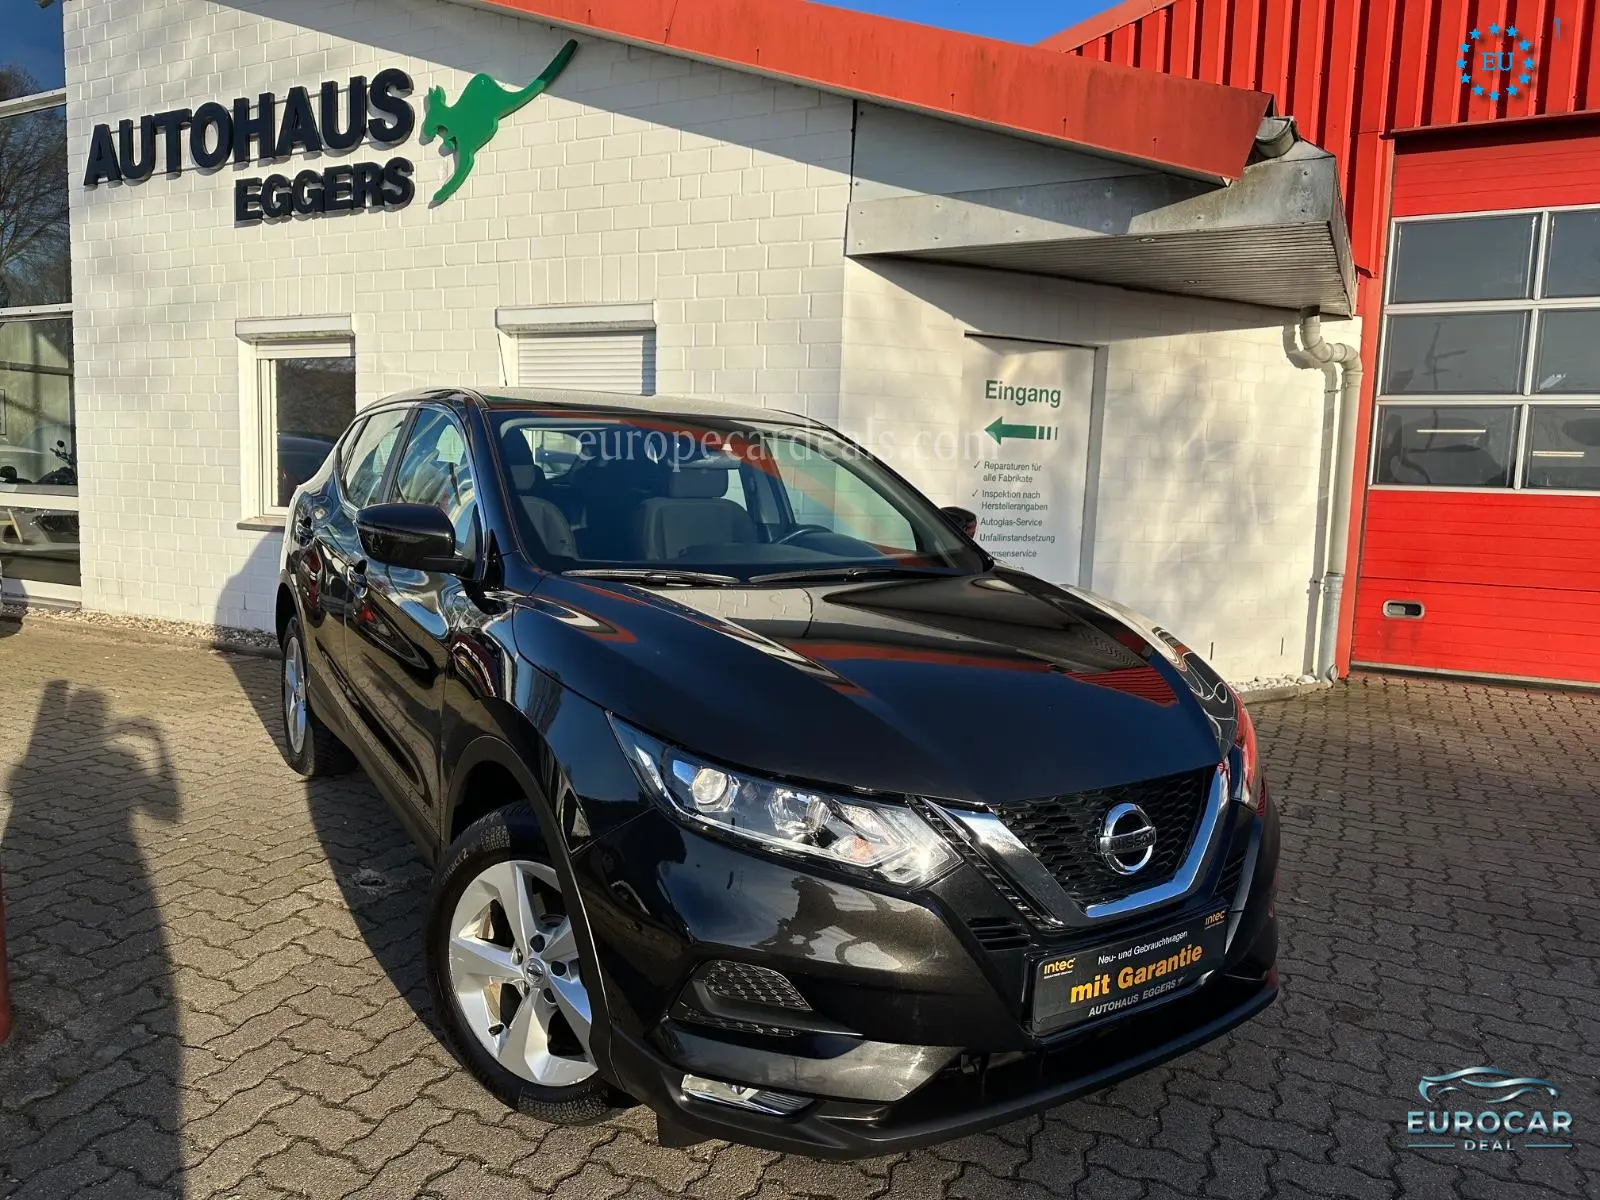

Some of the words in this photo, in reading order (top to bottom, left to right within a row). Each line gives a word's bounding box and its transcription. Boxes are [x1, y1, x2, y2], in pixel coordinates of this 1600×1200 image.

[84, 68, 415, 190] AUTOHAUS
[235, 157, 415, 227] EGGERS
[985, 379, 1062, 408] Eingang
[984, 460, 1030, 473] Reparaturen
[1031, 462, 1042, 471] für
[983, 474, 997, 482] alle
[998, 474, 1033, 484] Fabrikate
[982, 490, 1021, 500] Inspektion
[1022, 491, 1041, 499] nach
[981, 502, 1048, 512] Herstellerangaben
[980, 518, 1043, 528] Autoglas-Service
[979, 533, 1055, 544] Unfallinstandsetzung
[1098, 952, 1116, 965] Neu-
[1118, 947, 1132, 961] und
[1134, 930, 1188, 956] Gebrauchtwagen
[1070, 975, 1111, 1004] mit
[1117, 944, 1203, 989] Garantie
[1088, 993, 1139, 1018] AUTOHAUS
[1142, 977, 1177, 1000] EGGERS
